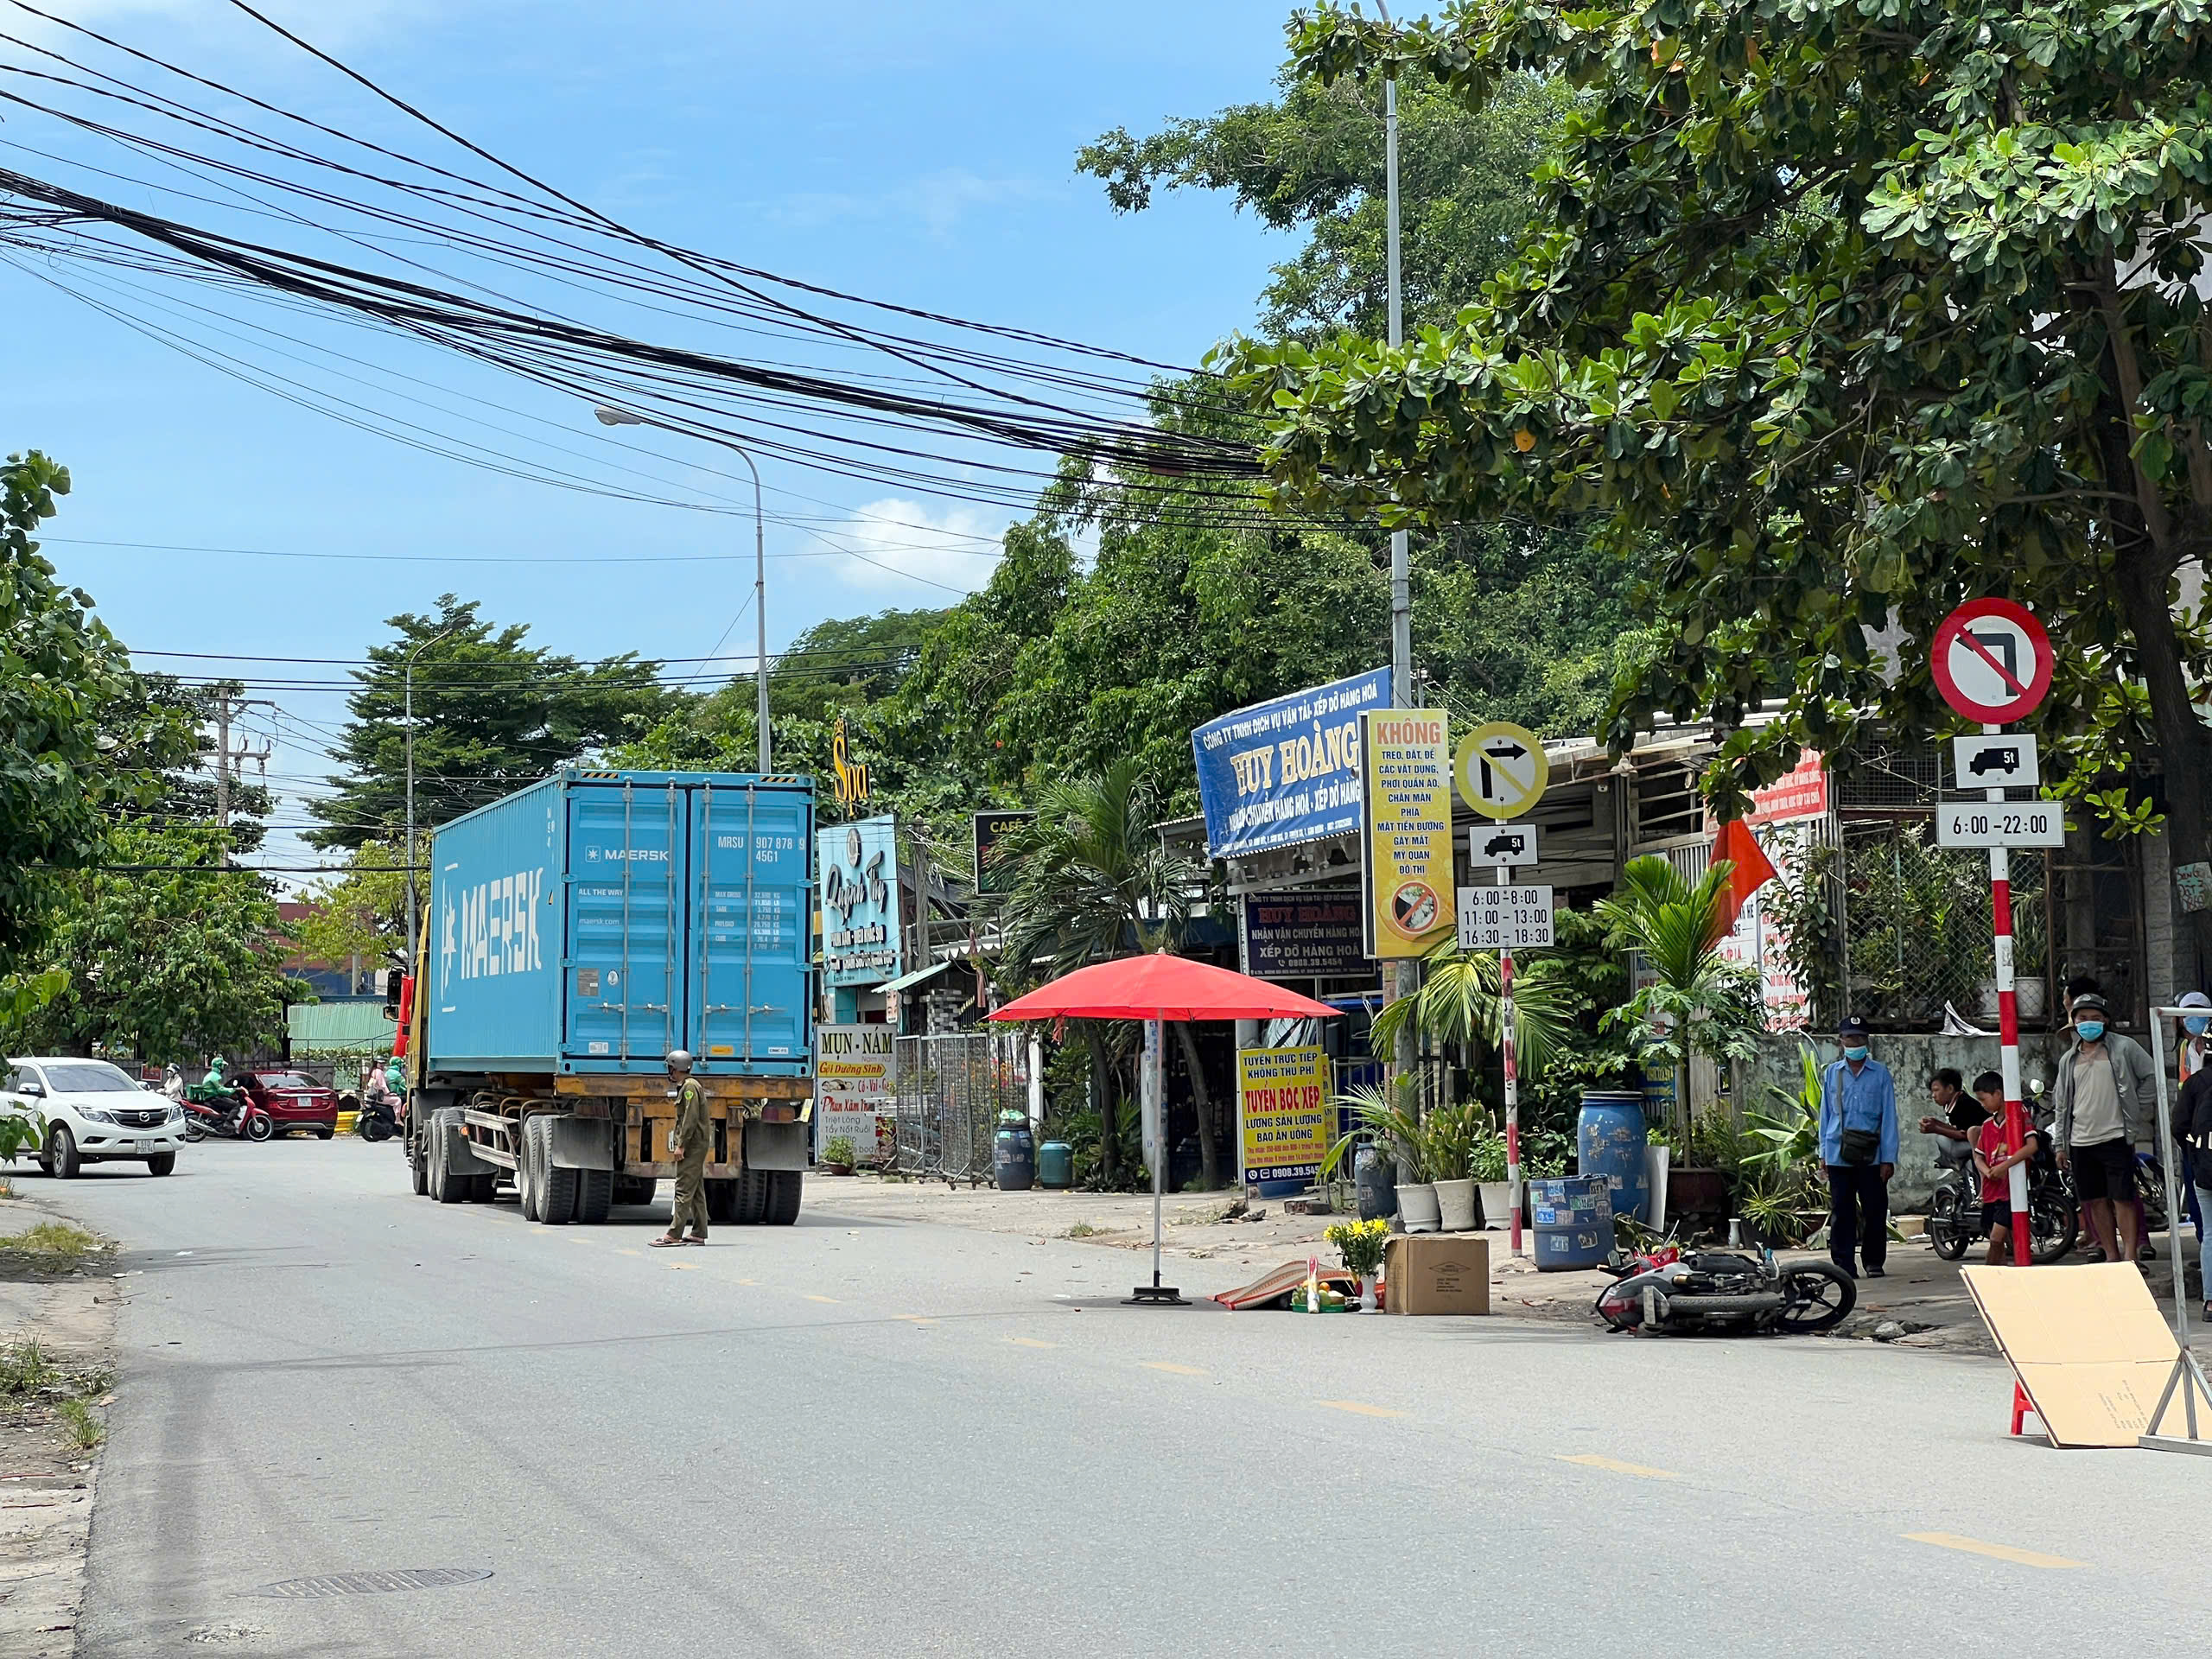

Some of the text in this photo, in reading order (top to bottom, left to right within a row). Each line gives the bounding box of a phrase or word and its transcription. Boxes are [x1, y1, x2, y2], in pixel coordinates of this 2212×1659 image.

[1222, 727, 1231, 742] TY
[1232, 721, 1252, 740] TNHH
[1253, 715, 1269, 737] DỊCH
[1270, 712, 1281, 732] VỤ
[1281, 706, 1297, 729] VẬN
[1313, 693, 1327, 717] XẾP
[1340, 687, 1360, 709] HÀNG
[1362, 678, 1377, 702] HOÁ
[1376, 717, 1440, 744] KHÔNG
[1230, 719, 1360, 797] HUY HOÀNG
[2003, 752, 2015, 764] 5t
[833, 735, 869, 816] Spa
[1379, 764, 1395, 773] CÁC
[1313, 779, 1328, 812] XẾP
[1340, 776, 1360, 806] HÀNG
[718, 836, 805, 850] MRSU 907 878 9
[1511, 837, 1522, 847] 5t
[605, 849, 669, 861] MAERSK
[755, 850, 779, 862] 45G1
[1408, 851, 1430, 860] QUAN
[1472, 891, 1499, 906] 6:00
[1511, 890, 1537, 905] 8:00
[1258, 903, 1356, 924] HUY HOÀNG
[1465, 910, 1498, 925] 11:00
[1514, 909, 1547, 924] 13:00
[461, 868, 543, 980] MAERSK
[1252, 926, 1274, 943] NHẬN
[1276, 926, 1292, 942] VẬN
[1293, 924, 1325, 939] CHUYỂN
[1325, 925, 1347, 938] HÀNG
[1465, 929, 1499, 944] 16:30
[1515, 928, 1548, 943] 18:30
[1259, 943, 1281, 958] XẾP
[1302, 943, 1333, 957] HÀNG
[1337, 942, 1360, 956] HOÁ
[1288, 958, 1343, 967] 0908.39.5454
[821, 1033, 853, 1060] MỤN
[862, 1027, 893, 1054] NÁM
[819, 1061, 882, 1074] Gội Dưỡng Sinh
[1248, 1067, 1278, 1079] KHÔNG
[1281, 1066, 1297, 1077] THU
[821, 1096, 842, 1112] Phun
[844, 1098, 859, 1112] Xăm
[1245, 1078, 1320, 1114] TUYỂN BỐC XẾP
[824, 1125, 838, 1134] Tẩy
[1245, 1117, 1273, 1129] LƯƠNG
[1275, 1114, 1293, 1127] SẢN
[1257, 1131, 1274, 1142] BAO
[1272, 1166, 1325, 1178] 0908.39.545
